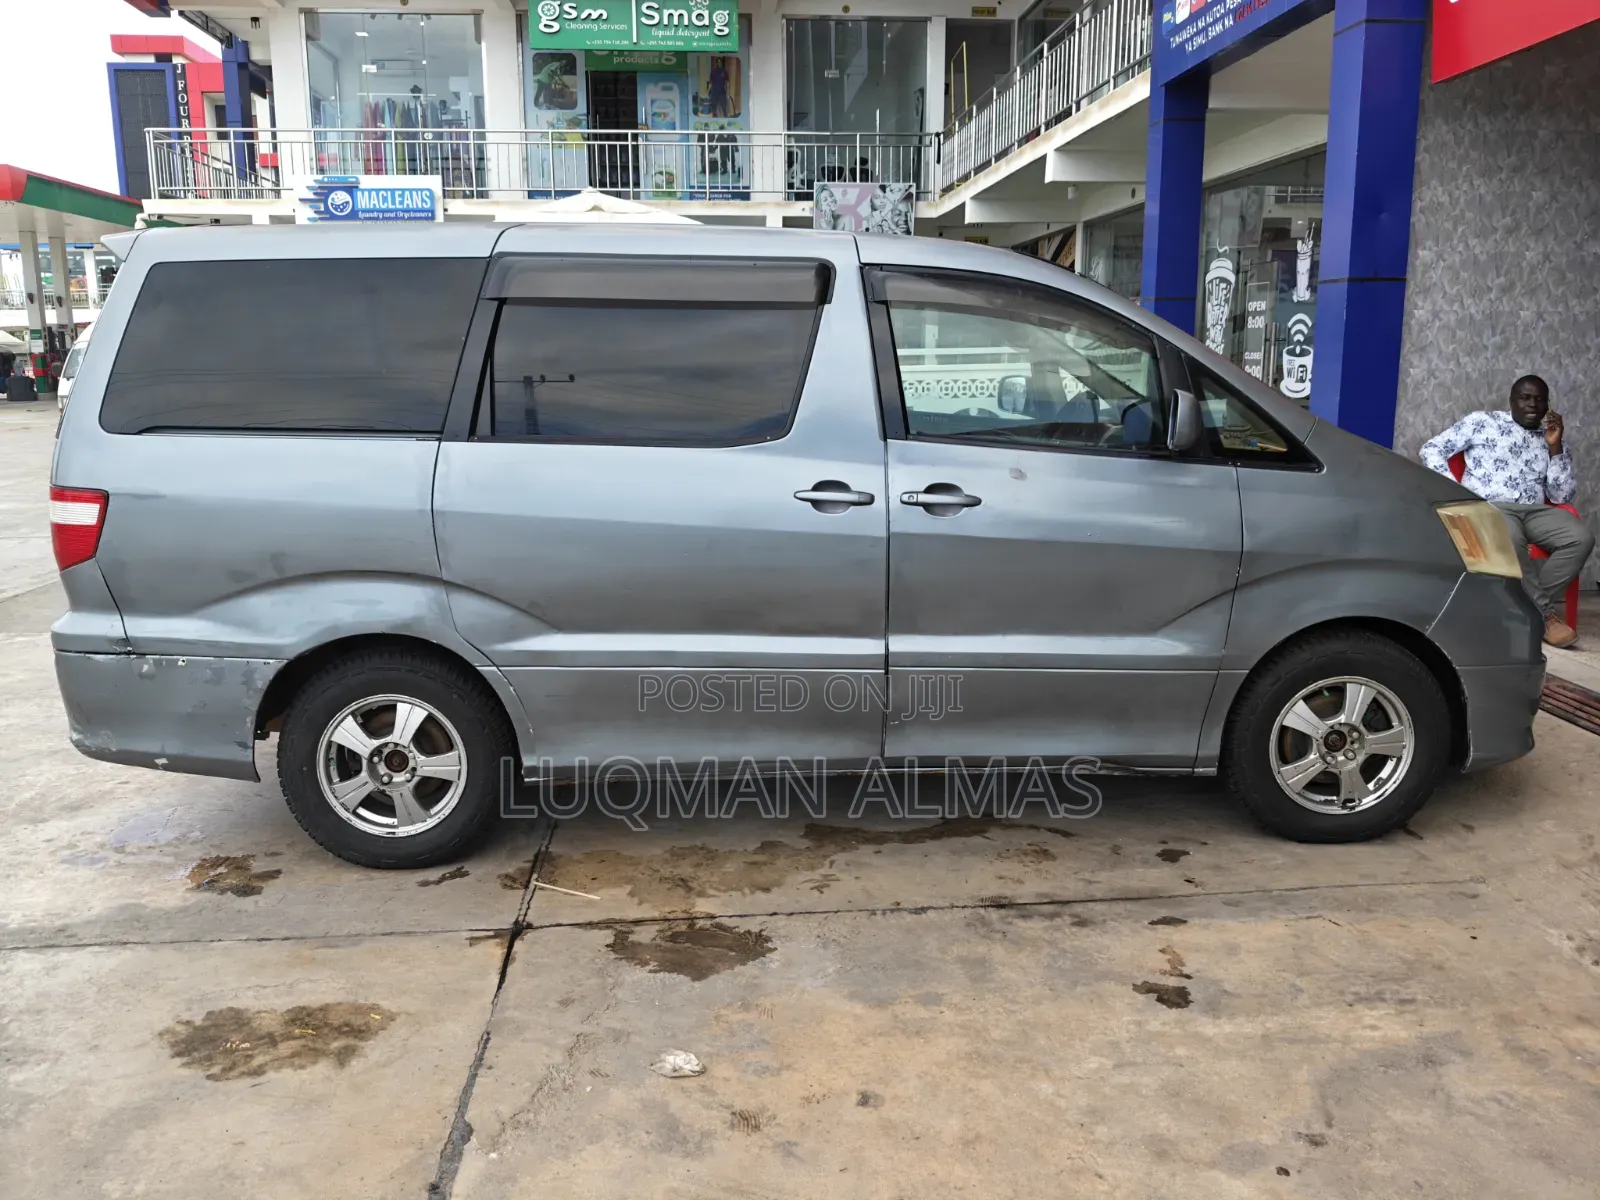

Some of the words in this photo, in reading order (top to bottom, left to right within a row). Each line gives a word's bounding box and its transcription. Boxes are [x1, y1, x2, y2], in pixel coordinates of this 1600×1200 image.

[640, 1, 730, 36] Smag
[565, 21, 598, 31] Cleaning
[599, 22, 628, 30] Services
[1169, 21, 1197, 49] TUNAWEKA
[1197, 15, 1206, 31] NA
[1206, 5, 1225, 26] KUTOA
[1208, 21, 1224, 40] BANK
[1224, 14, 1234, 30] NA
[651, 28, 675, 38] liquid
[676, 28, 711, 38] detergent
[613, 55, 659, 65] products
[176, 63, 183, 74] J
[177, 80, 190, 129] FOUR
[357, 190, 431, 209] MACLEANS
[1248, 301, 1266, 311] OPEN
[1247, 316, 1265, 328] 8:00
[1244, 352, 1261, 360] CLOSE
